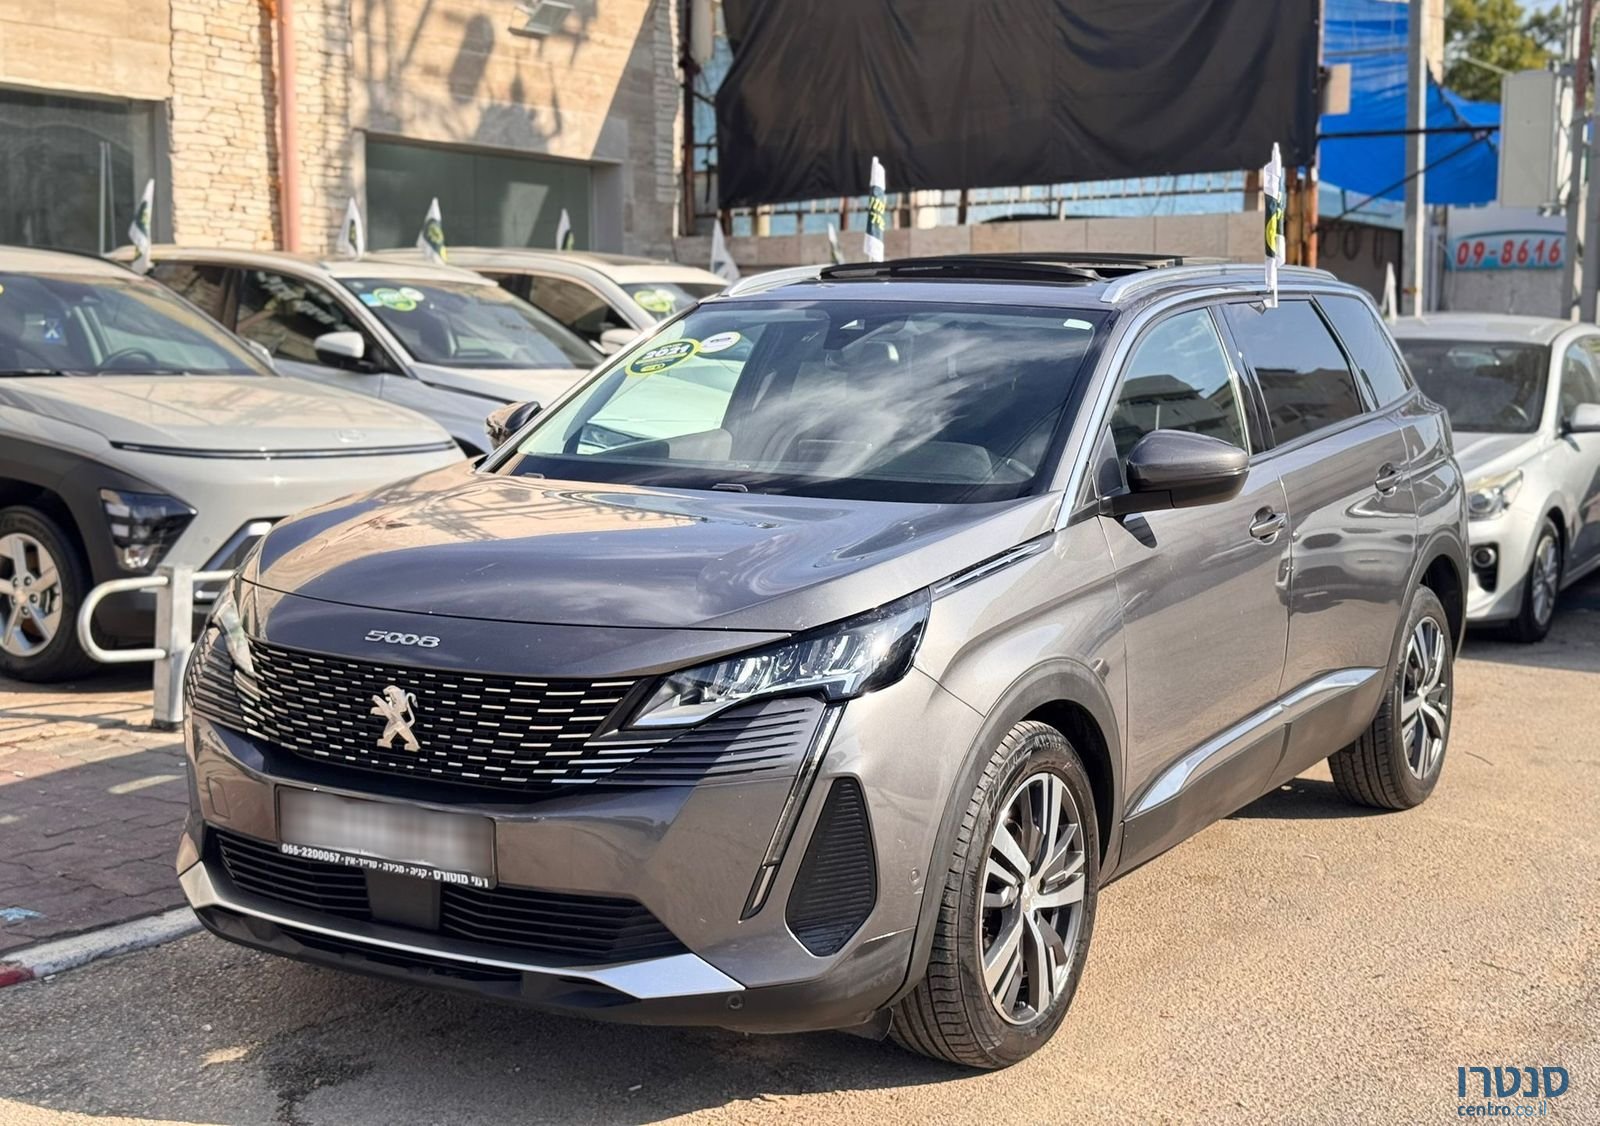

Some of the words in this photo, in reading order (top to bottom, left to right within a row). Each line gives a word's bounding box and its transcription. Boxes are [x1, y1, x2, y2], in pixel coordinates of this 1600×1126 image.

[644, 345, 690, 360] 2021
[364, 629, 441, 648] 5008
[433, 870, 469, 885] מוטורס
